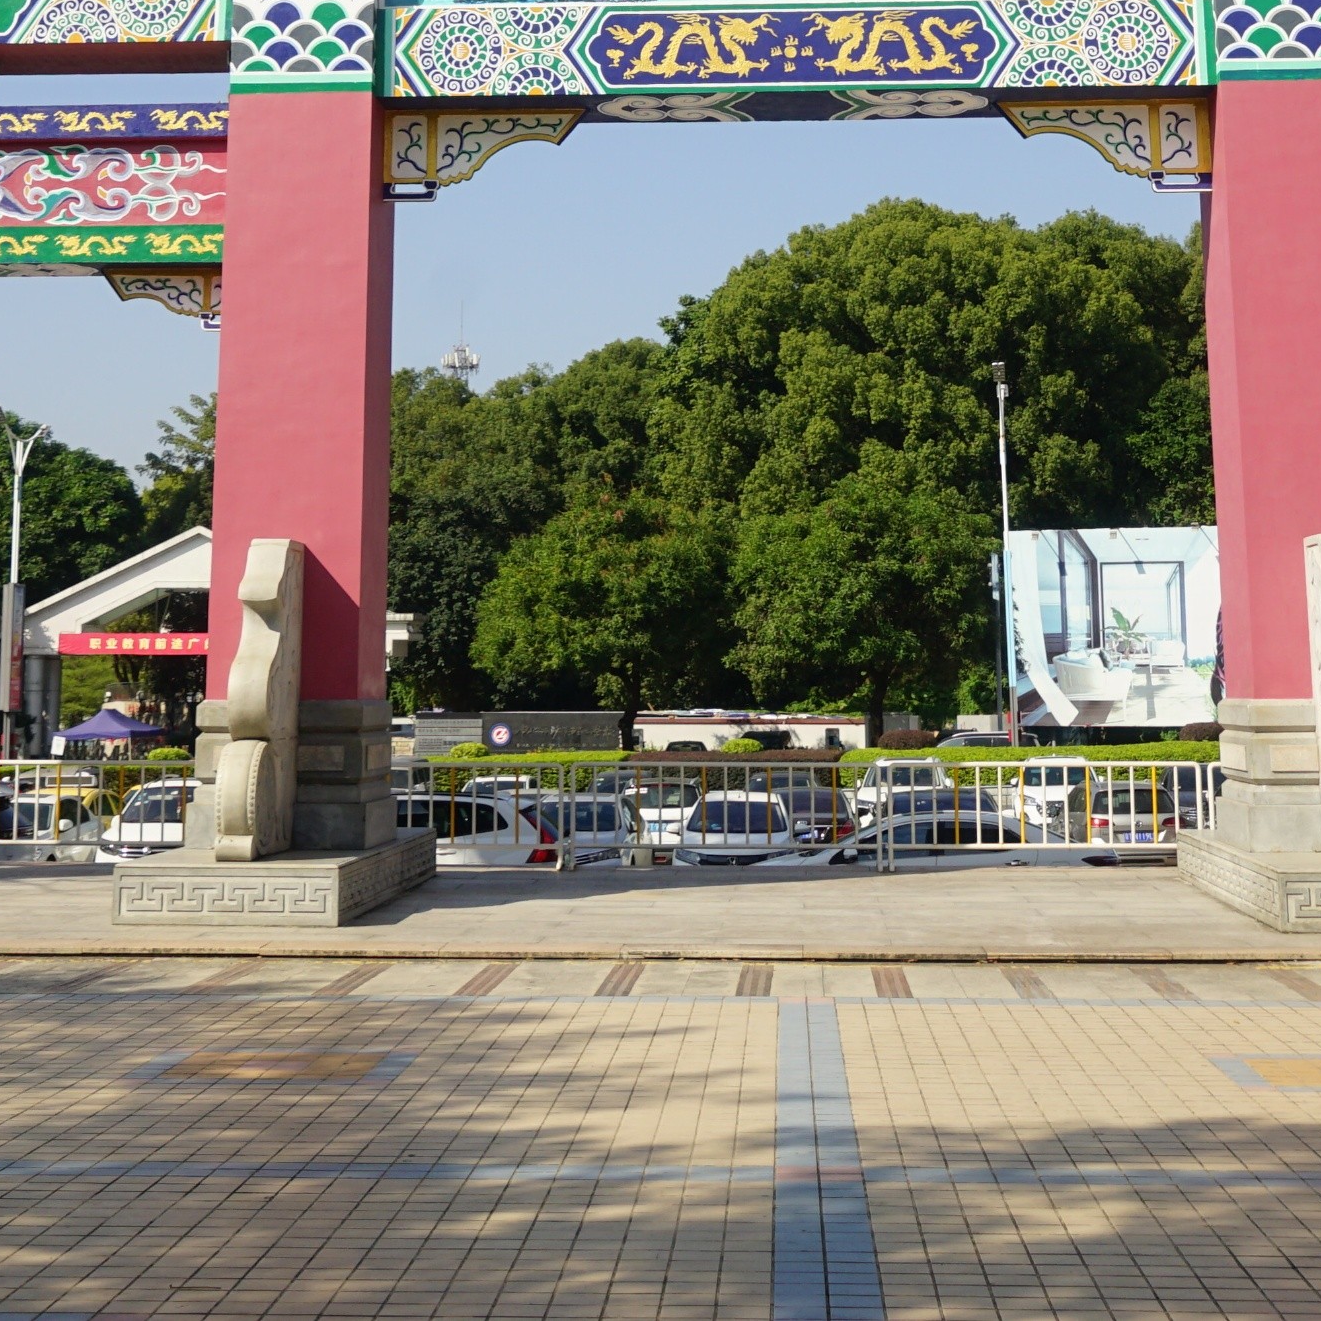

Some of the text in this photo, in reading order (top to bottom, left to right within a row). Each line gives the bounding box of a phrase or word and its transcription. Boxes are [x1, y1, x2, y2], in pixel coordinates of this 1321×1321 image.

[89, 637, 209, 650] 职业教育前途广
